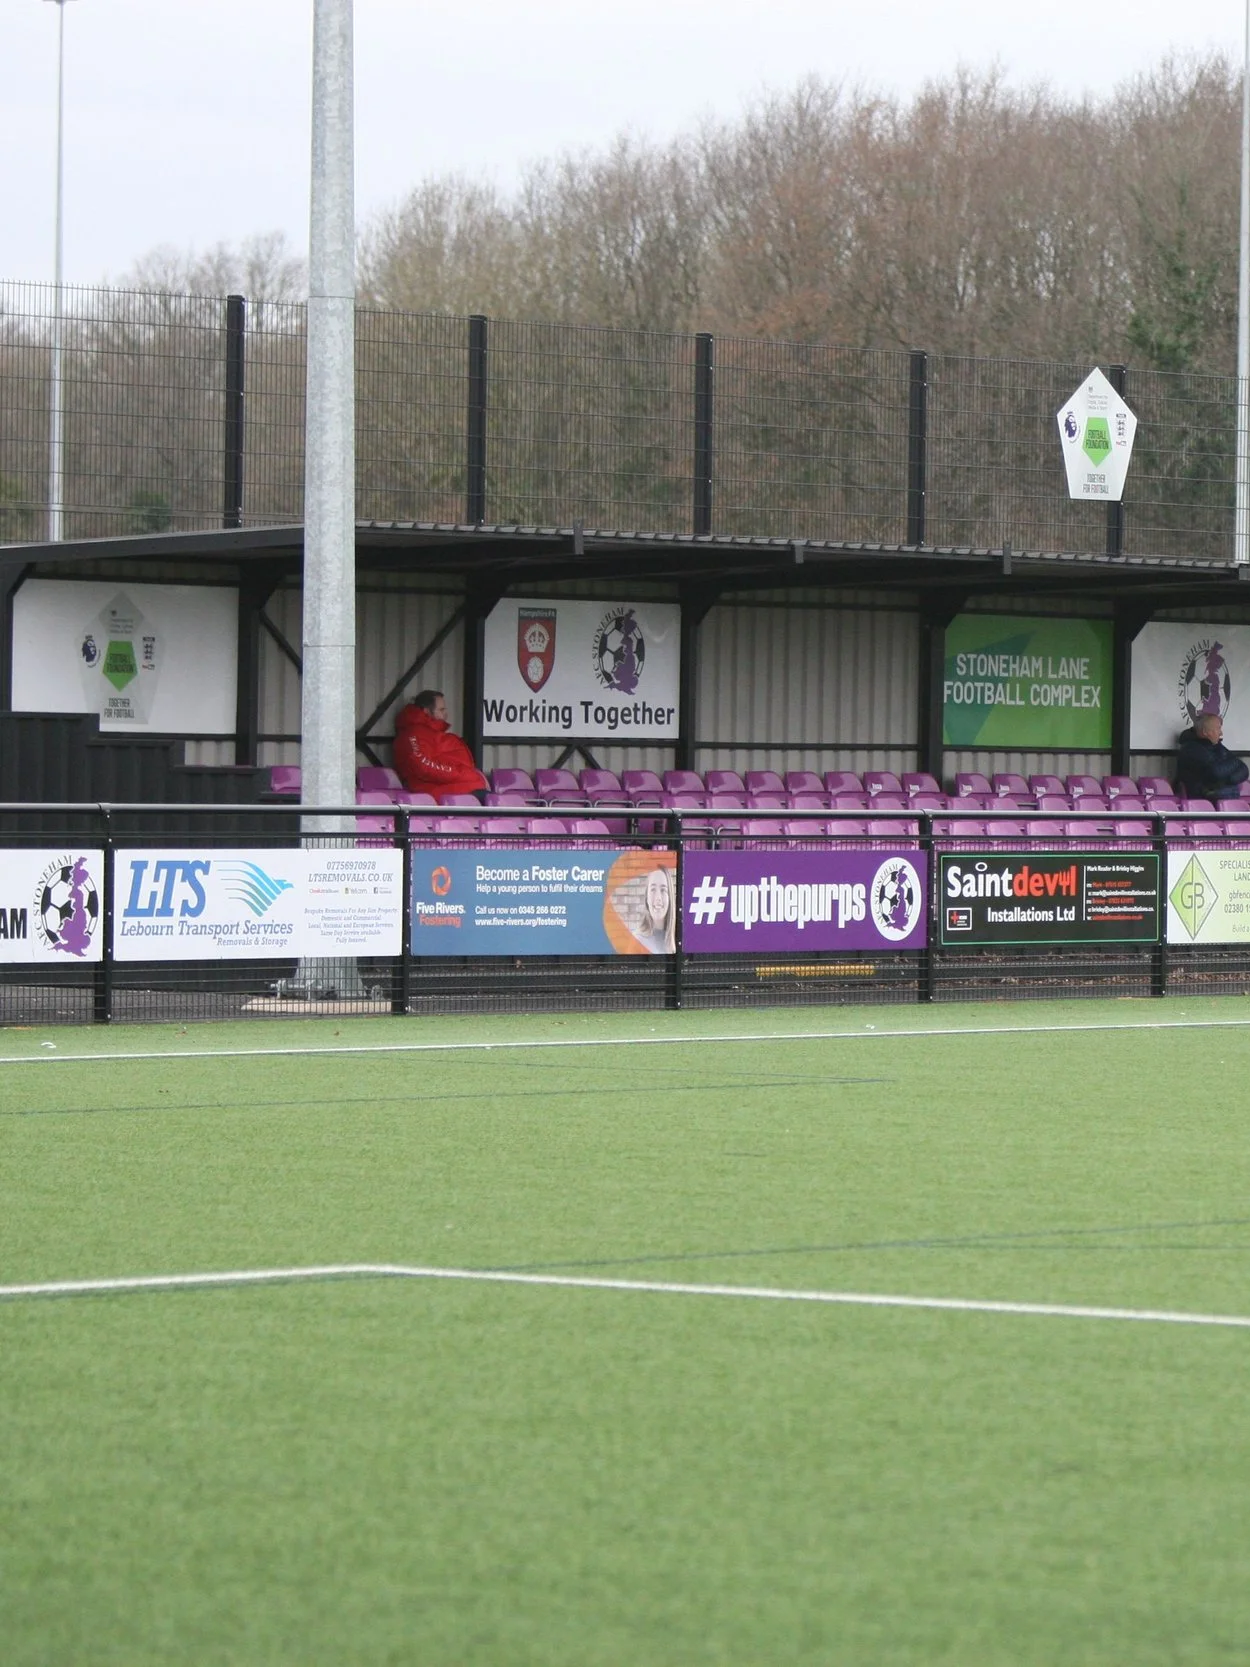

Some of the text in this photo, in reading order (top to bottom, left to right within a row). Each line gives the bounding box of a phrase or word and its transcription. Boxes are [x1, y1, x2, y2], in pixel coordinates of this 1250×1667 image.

[1088, 430, 1106, 439] FOOTBALL
[1086, 440, 1109, 449] FOUNDATION
[1087, 474, 1105, 483] TOGETHER
[1091, 485, 1109, 494] FOOTBALL
[592, 607, 624, 660] STONEHAM
[956, 654, 1090, 679] STONEHAM LANE
[1178, 639, 1210, 697] STONEHAM
[944, 681, 1101, 708] FOOTBALL COMPLEX
[109, 698, 130, 708] TOGETHER
[104, 708, 135, 718] FOR FOOTBALL
[483, 699, 675, 730] Working Together
[308, 873, 393, 882] LTSREMOVALS.CO.UK
[476, 866, 605, 881] Become a Foster Carer
[33, 855, 72, 917] STONEHAM
[122, 860, 211, 918] LTS
[476, 884, 491, 894] Help
[498, 885, 517, 895] young
[518, 885, 540, 895] person
[541, 884, 548, 892] to
[549, 884, 563, 892] fulfil
[564, 884, 578, 892] their
[579, 884, 603, 893] dreams
[1180, 881, 1205, 909] GB
[416, 902, 435, 914] Five
[689, 876, 866, 930] #upthepurps
[1224, 904, 1243, 914] 02380
[475, 906, 487, 915] Call
[519, 906, 535, 914] 0345
[550, 906, 566, 914] 0272
[987, 906, 1054, 923] Installations
[1056, 906, 1076, 922] Ltd
[419, 915, 461, 928] Fostering
[475, 917, 567, 927] www.five-rivers.org/fostering
[120, 919, 293, 940] Lebourn Transport Services
[1232, 924, 1245, 933] Build
[217, 937, 252, 946] Removals
[261, 937, 288, 947] Storage
